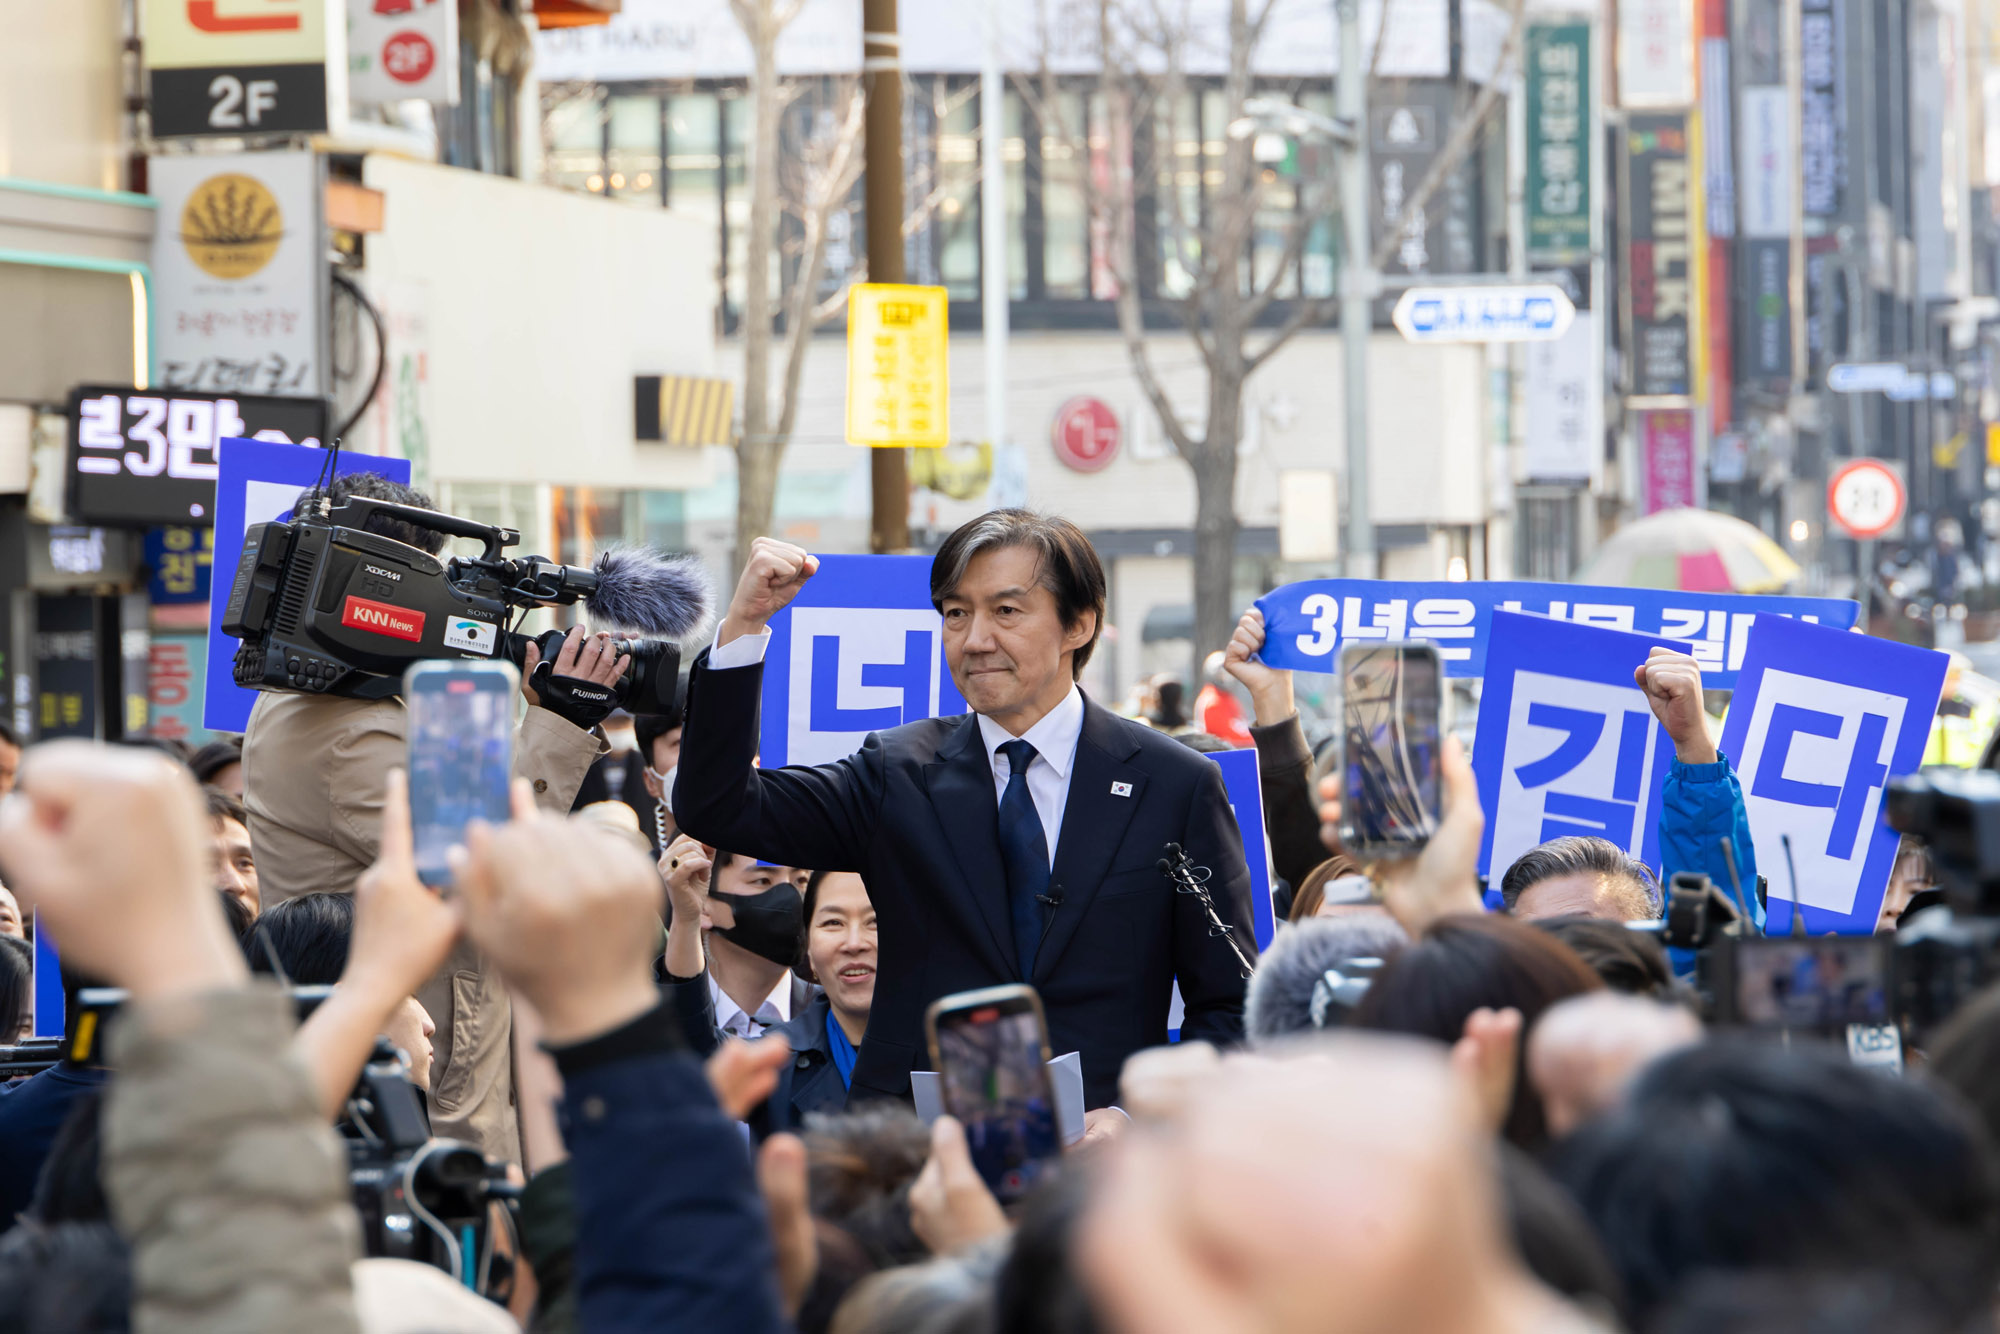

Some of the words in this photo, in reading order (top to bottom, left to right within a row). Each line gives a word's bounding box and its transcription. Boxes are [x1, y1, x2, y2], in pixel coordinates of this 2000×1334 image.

[388, 41, 429, 73] 2F
[208, 74, 278, 128] 2F
[1652, 158, 1687, 323] MILK
[360, 577, 395, 599] HD
[364, 564, 401, 582] XDCAM
[353, 606, 390, 627] KNN
[389, 618, 414, 633] News
[466, 608, 496, 620] SONY
[1296, 593, 1477, 661] 3년은
[572, 688, 609, 701] FUJINON
[809, 630, 933, 733] 너
[1513, 701, 1651, 853] 길
[1750, 702, 1889, 861] 다
